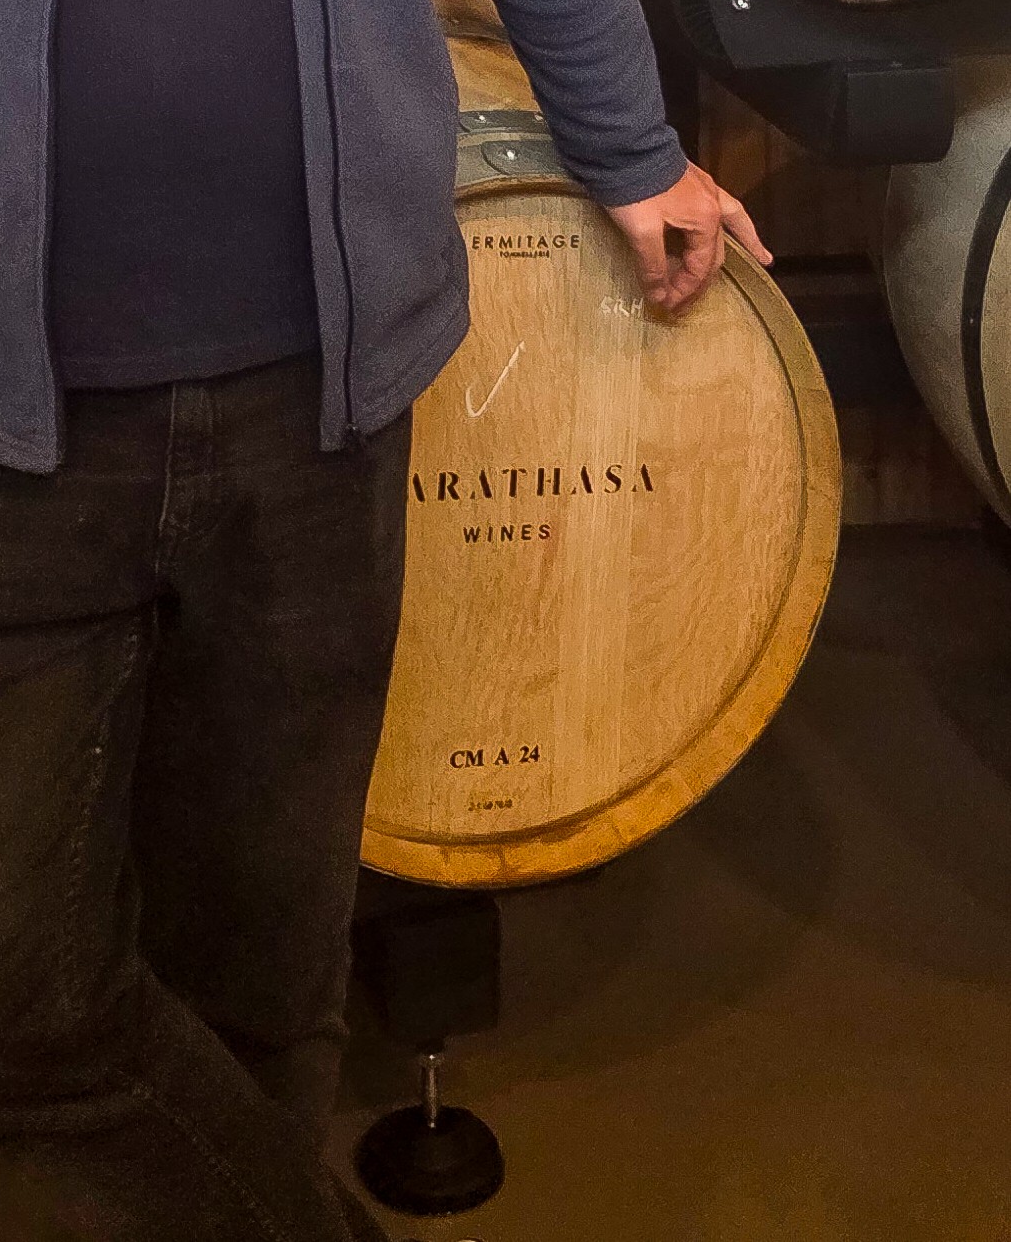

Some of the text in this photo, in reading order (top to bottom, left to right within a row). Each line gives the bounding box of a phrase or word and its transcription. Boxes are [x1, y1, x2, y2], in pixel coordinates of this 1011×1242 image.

[472, 234, 580, 249] ERMITAGE
[463, 524, 551, 544] WINES
[450, 745, 540, 768] CM A 24
